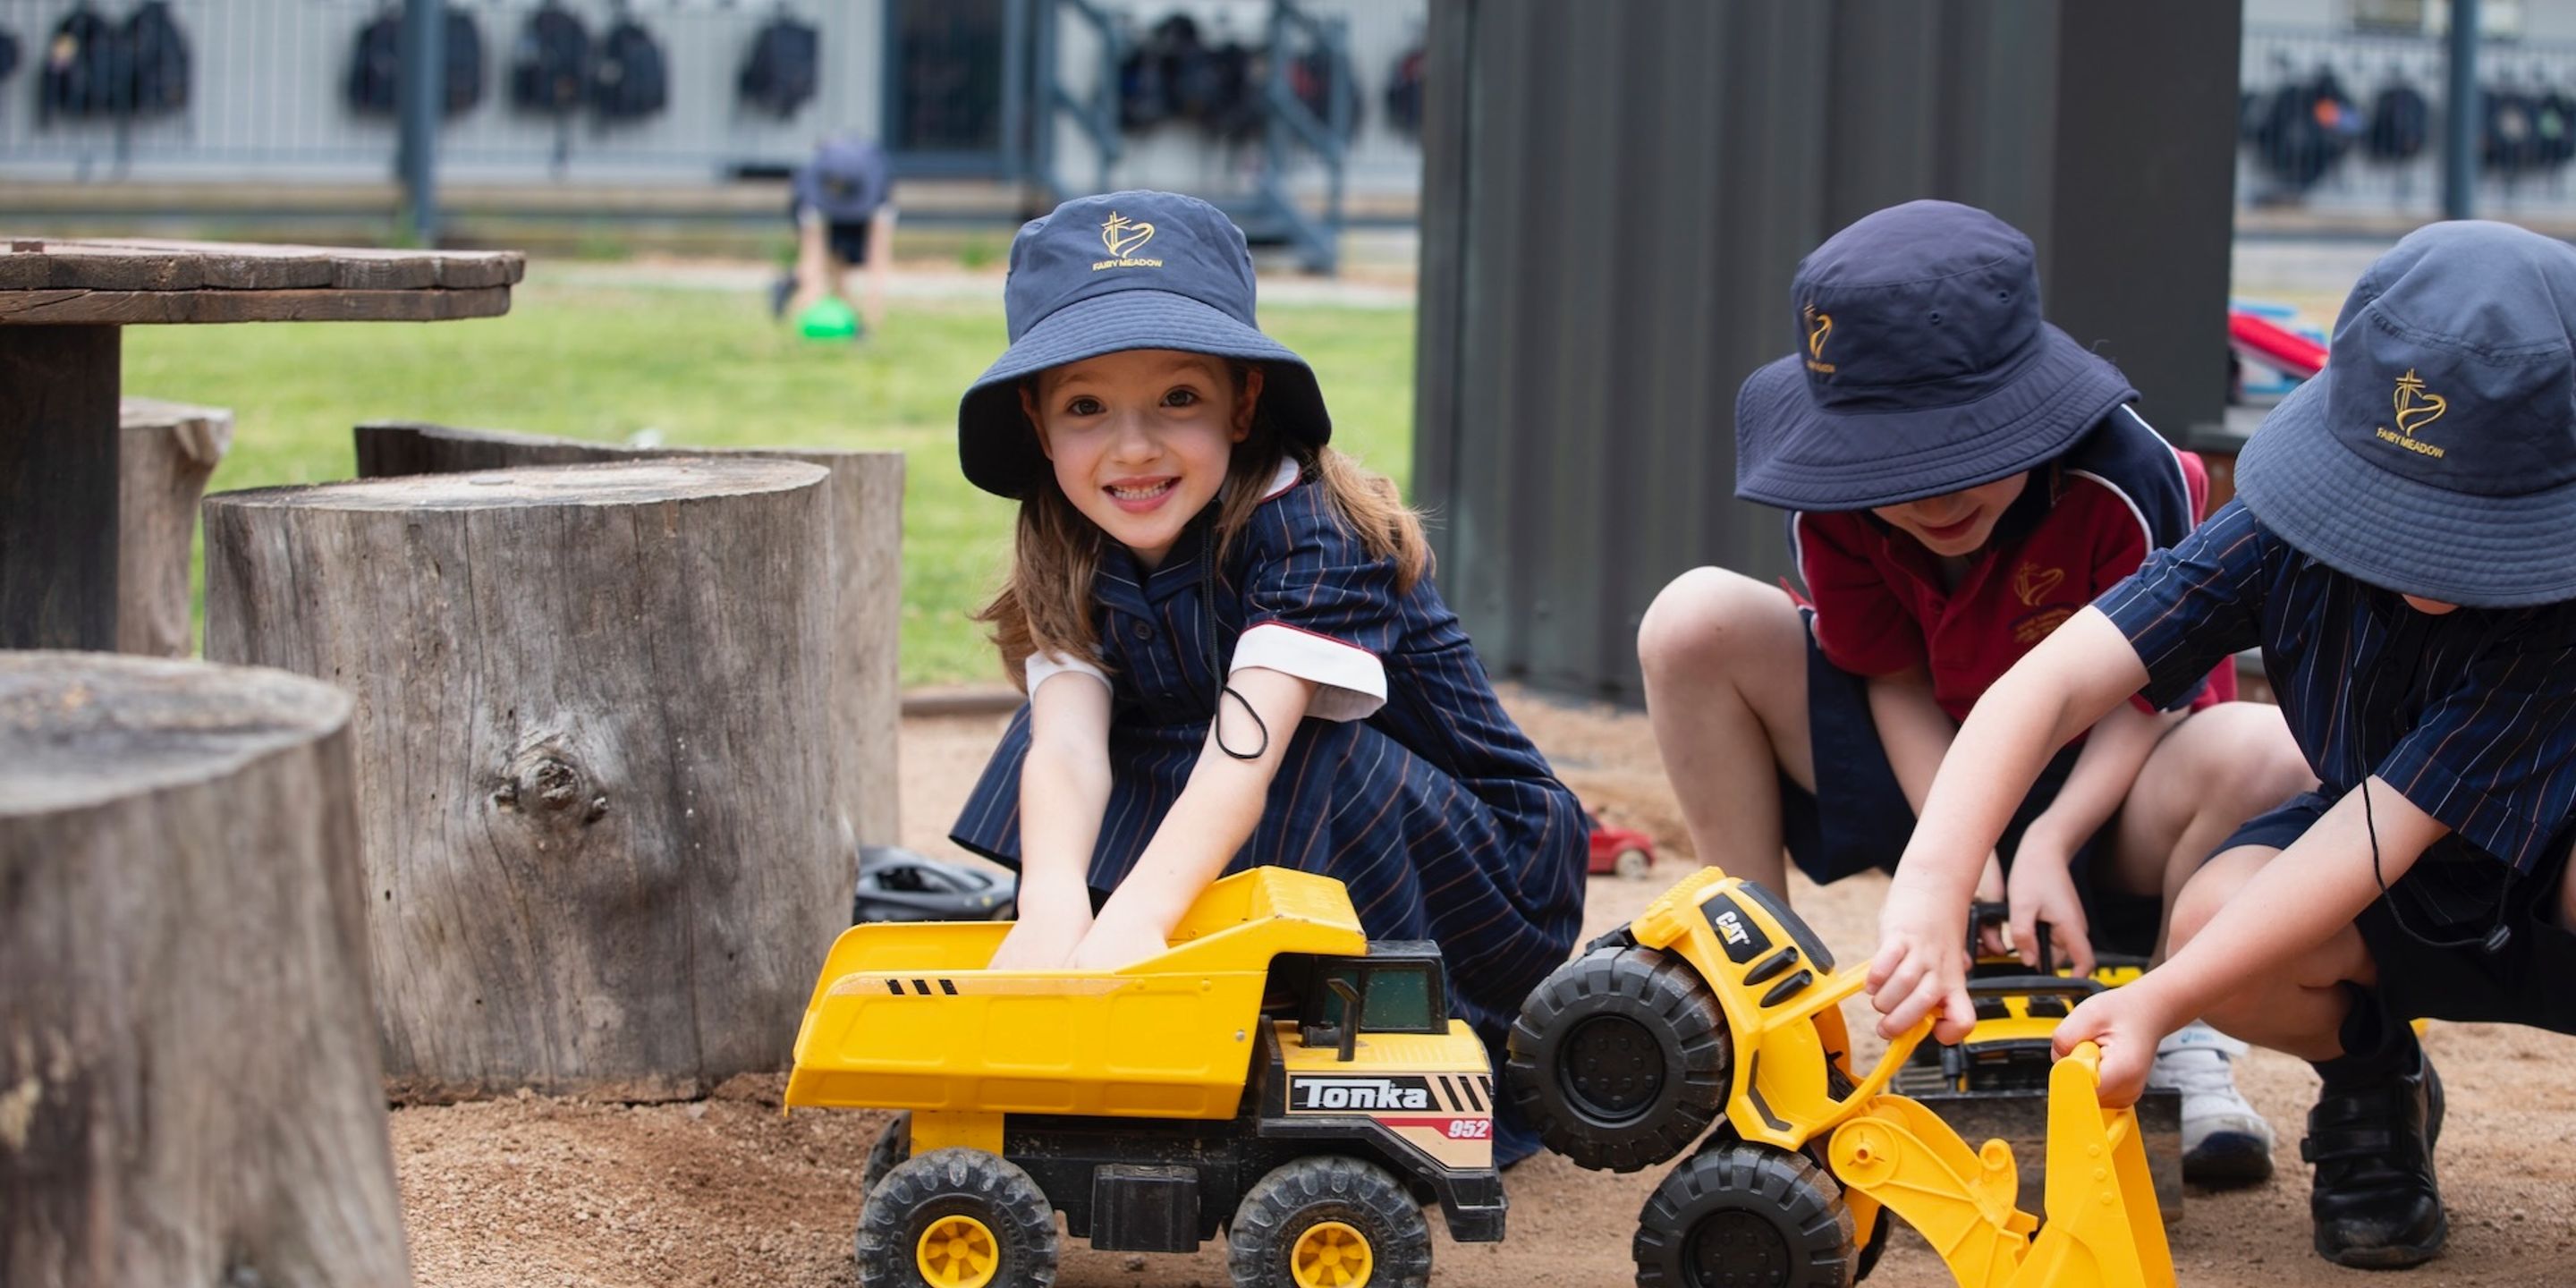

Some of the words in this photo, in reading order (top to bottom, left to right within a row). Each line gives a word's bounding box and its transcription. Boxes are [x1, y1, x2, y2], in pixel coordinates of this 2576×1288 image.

[1092, 259, 1117, 270] FAIRY
[1119, 258, 1162, 267] MEADOW
[2376, 428, 2401, 444] FAIRY
[2400, 437, 2445, 458] MEADOW
[1715, 911, 1750, 945] CAT
[1294, 1079, 1428, 1109] Tonka
[1448, 1120, 1489, 1138] 952
